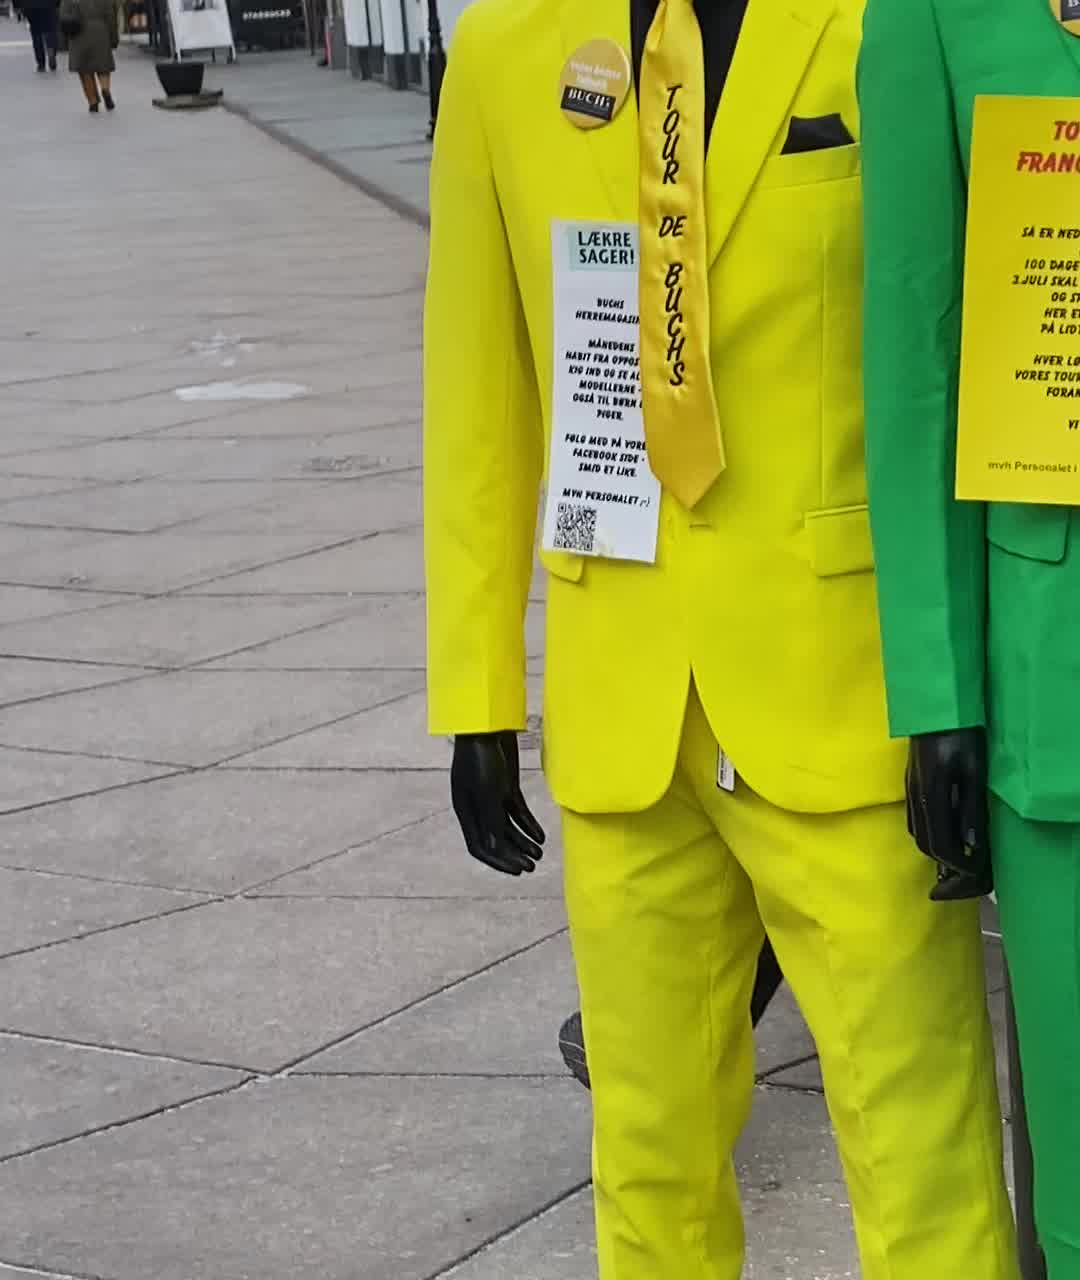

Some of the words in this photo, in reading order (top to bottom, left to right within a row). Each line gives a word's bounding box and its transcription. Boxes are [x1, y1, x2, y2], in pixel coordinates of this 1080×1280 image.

[662, 84, 682, 185] TOUR
[659, 215, 687, 238] DE
[1021, 226, 1036, 238] SÅ
[1039, 227, 1054, 239] ER
[578, 231, 631, 247] LÆKRE
[579, 248, 634, 265] SAGER!
[1025, 259, 1046, 270] 100
[1049, 260, 1080, 271] DAGE
[1050, 276, 1078, 287] SKAL
[597, 297, 624, 309] BUCHS
[1051, 292, 1067, 302] OG
[1044, 308, 1067, 319] HER
[664, 262, 686, 387] BUCHS
[1040, 322, 1055, 334] PÅ
[588, 338, 635, 352] MÅNEDENS
[565, 351, 591, 361] HABIT
[593, 353, 609, 364] FRA
[612, 355, 640, 366] OPPOS
[1033, 354, 1064, 366] HVER
[568, 365, 583, 375] KIG
[585, 367, 601, 377] IND
[604, 368, 615, 378] OG
[617, 370, 628, 380] SE
[1015, 370, 1051, 381] VORES
[579, 380, 635, 394] MODELLERNE
[572, 392, 594, 403] OGSÅ
[597, 395, 610, 405] TIL
[1068, 419, 1080, 430] VI
[588, 435, 608, 446] MED
[611, 437, 622, 448] PÅ
[625, 440, 646, 450] VORE
[573, 448, 618, 461] FACEBOOK
[619, 453, 639, 464] SIDE
[578, 462, 601, 473] SMID
[603, 465, 615, 475] ET
[585, 490, 639, 505] PERSONALET
